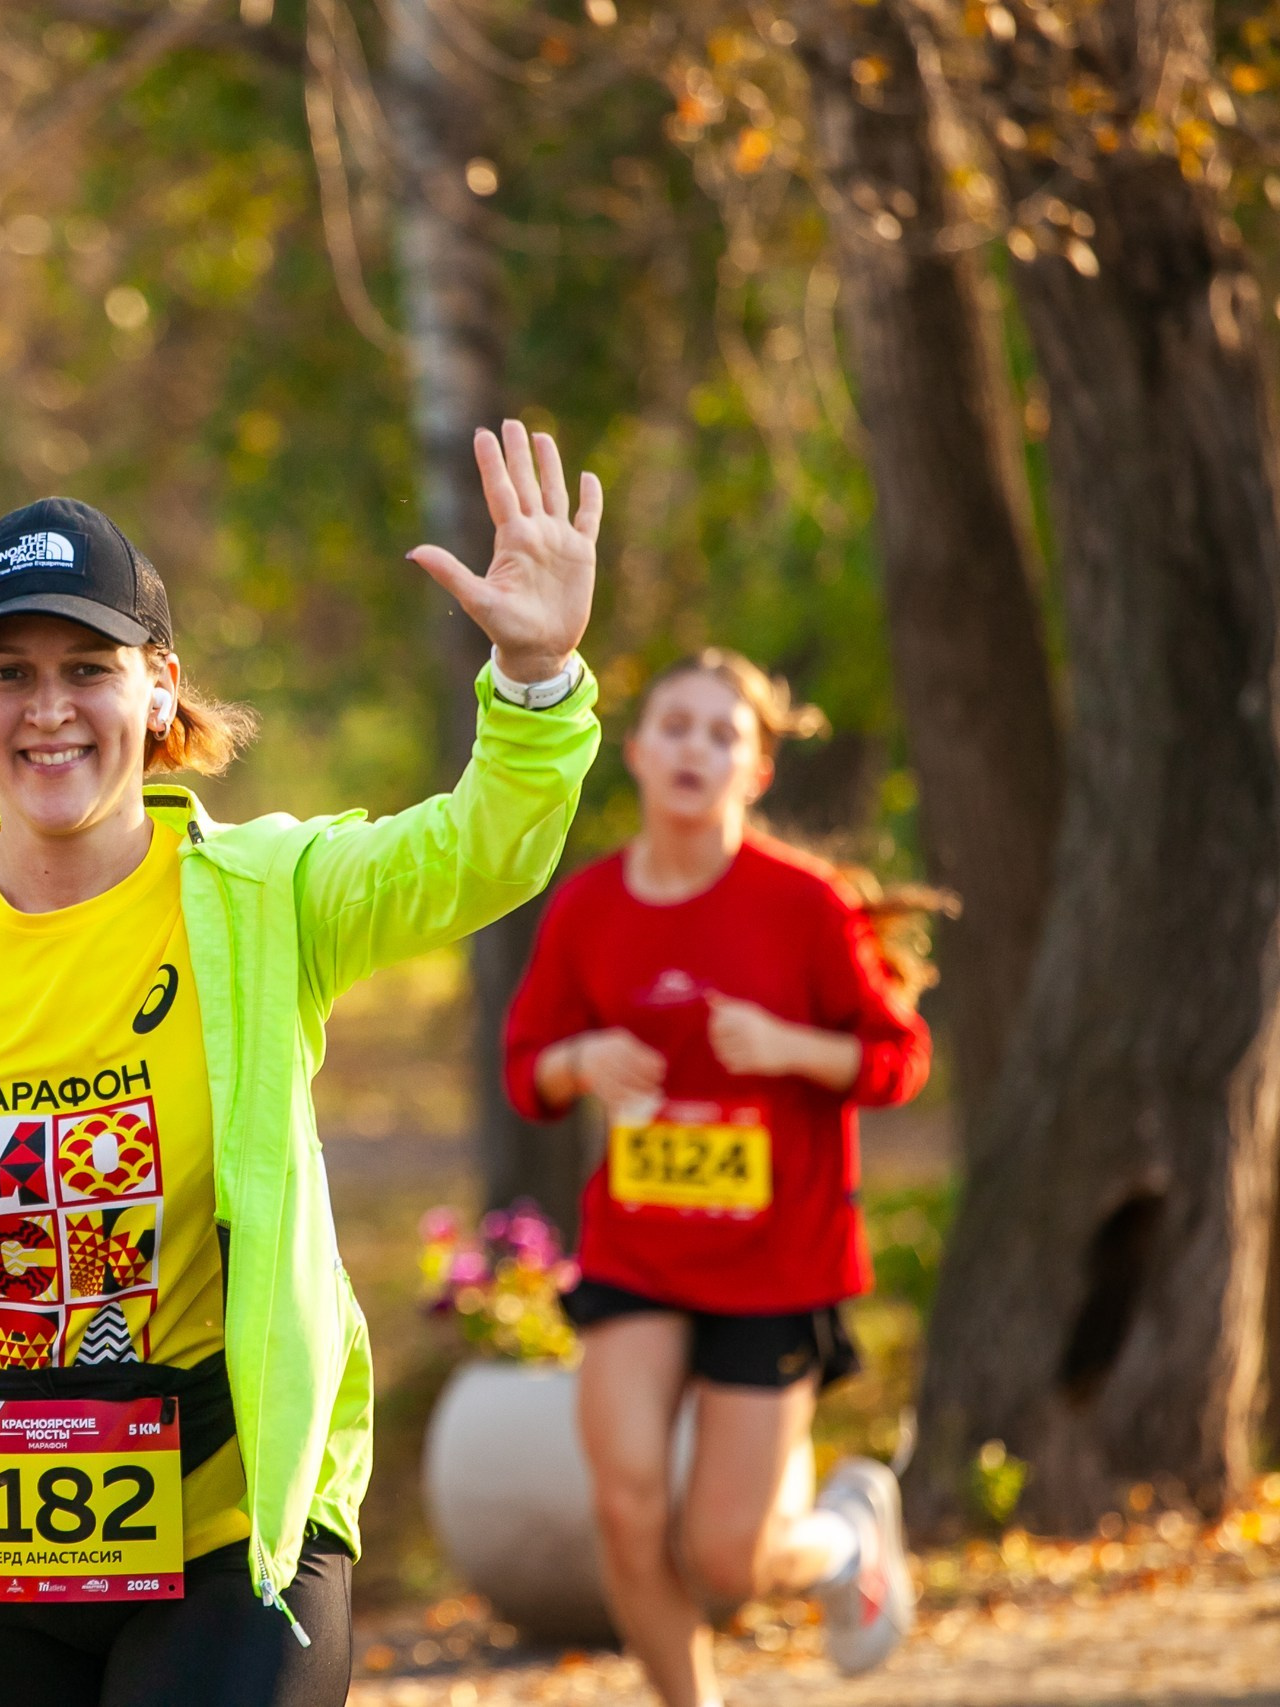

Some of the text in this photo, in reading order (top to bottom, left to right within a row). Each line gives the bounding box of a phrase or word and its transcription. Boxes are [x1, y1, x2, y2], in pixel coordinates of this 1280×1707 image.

[19, 532, 47, 546] THE
[9, 551, 45, 566] FACE
[629, 1131, 748, 1185] 5124
[1, 1418, 96, 1429] КРАСНОЯРСКИЕ
[128, 1423, 161, 1436] 5 КМ
[26, 1430, 70, 1440] МОСТЫ
[26, 1550, 122, 1564] АНАСТАСИЯ
[127, 1579, 159, 1591] 2026
